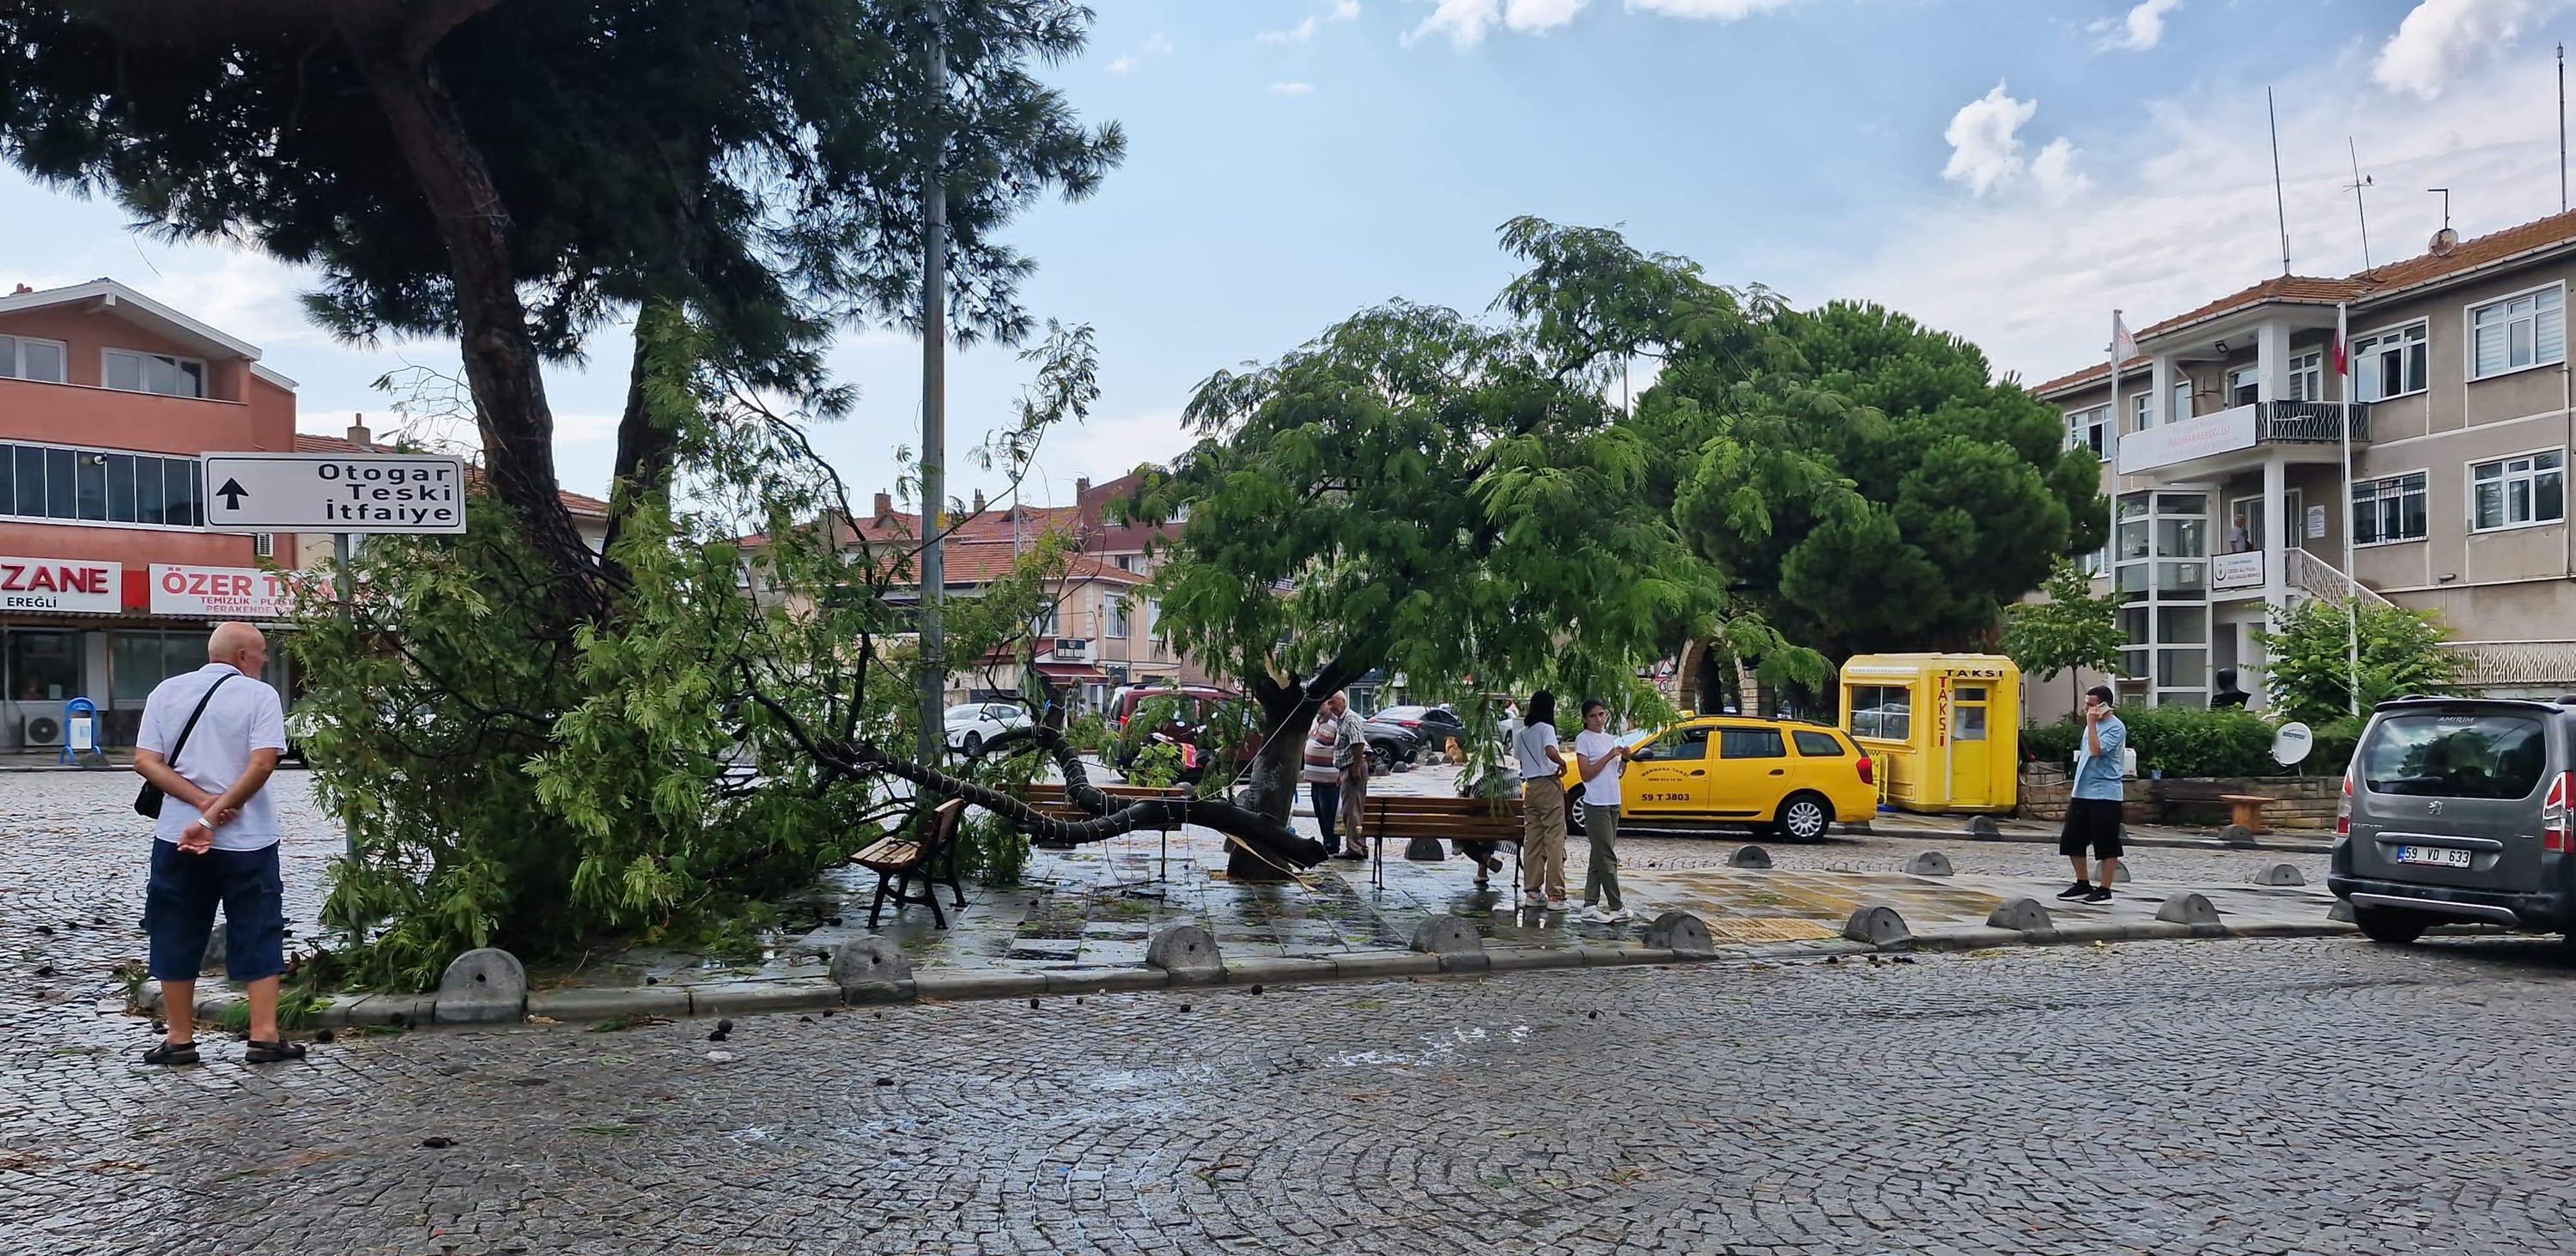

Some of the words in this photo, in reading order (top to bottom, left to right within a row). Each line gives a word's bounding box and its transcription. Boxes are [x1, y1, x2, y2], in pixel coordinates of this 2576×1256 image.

[318, 464, 451, 485] Otogar
[345, 483, 451, 501] Teski
[326, 499, 453, 524] İtfaiye
[1, 563, 109, 594] ZANE
[161, 567, 252, 596] ÖZER
[7, 596, 58, 609] EREĞLİ
[200, 596, 250, 605] TEMİZLİK
[206, 604, 271, 614] PERAKENDE
[1945, 669, 2003, 677] TAKSİ
[1938, 677, 1947, 747] TAKSİ
[2405, 846, 2418, 859] 59
[2427, 848, 2440, 861] VD
[2449, 850, 2470, 864] 633
